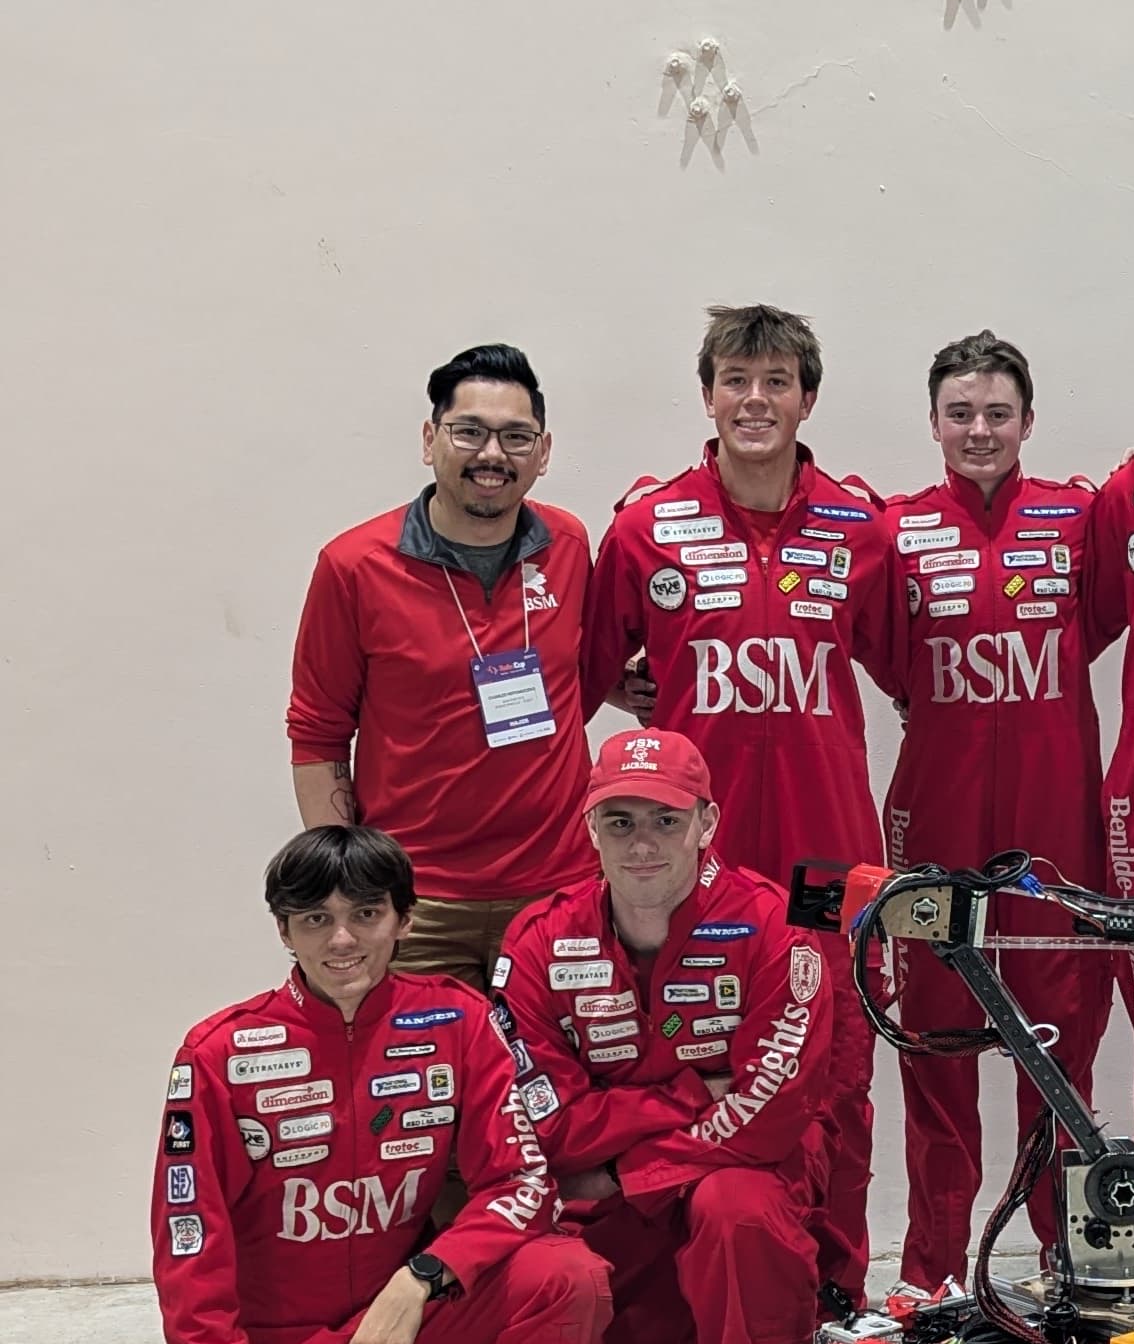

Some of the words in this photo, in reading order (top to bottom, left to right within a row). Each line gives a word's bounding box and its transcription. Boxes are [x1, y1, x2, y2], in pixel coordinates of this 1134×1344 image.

[813, 506, 867, 519] BANNER
[685, 550, 744, 561] dimension
[923, 558, 976, 570] dimension
[525, 594, 559, 611] BSM
[794, 603, 823, 614] trotec
[1020, 605, 1047, 614] trotec
[924, 628, 1064, 704] BSM
[687, 637, 837, 716] BSM
[395, 1012, 457, 1025] BANNER
[680, 1044, 715, 1056] trotec
[250, 1060, 301, 1074] STRATASYS
[691, 1102, 740, 1146] ed
[725, 1002, 811, 1127] Knights
[261, 1090, 330, 1108] dimension
[292, 1122, 319, 1134] LOGIC
[172, 1140, 192, 1150] FIRST
[385, 1140, 420, 1154] trotec
[276, 1167, 428, 1244] BSM
[487, 1184, 543, 1231] Re
